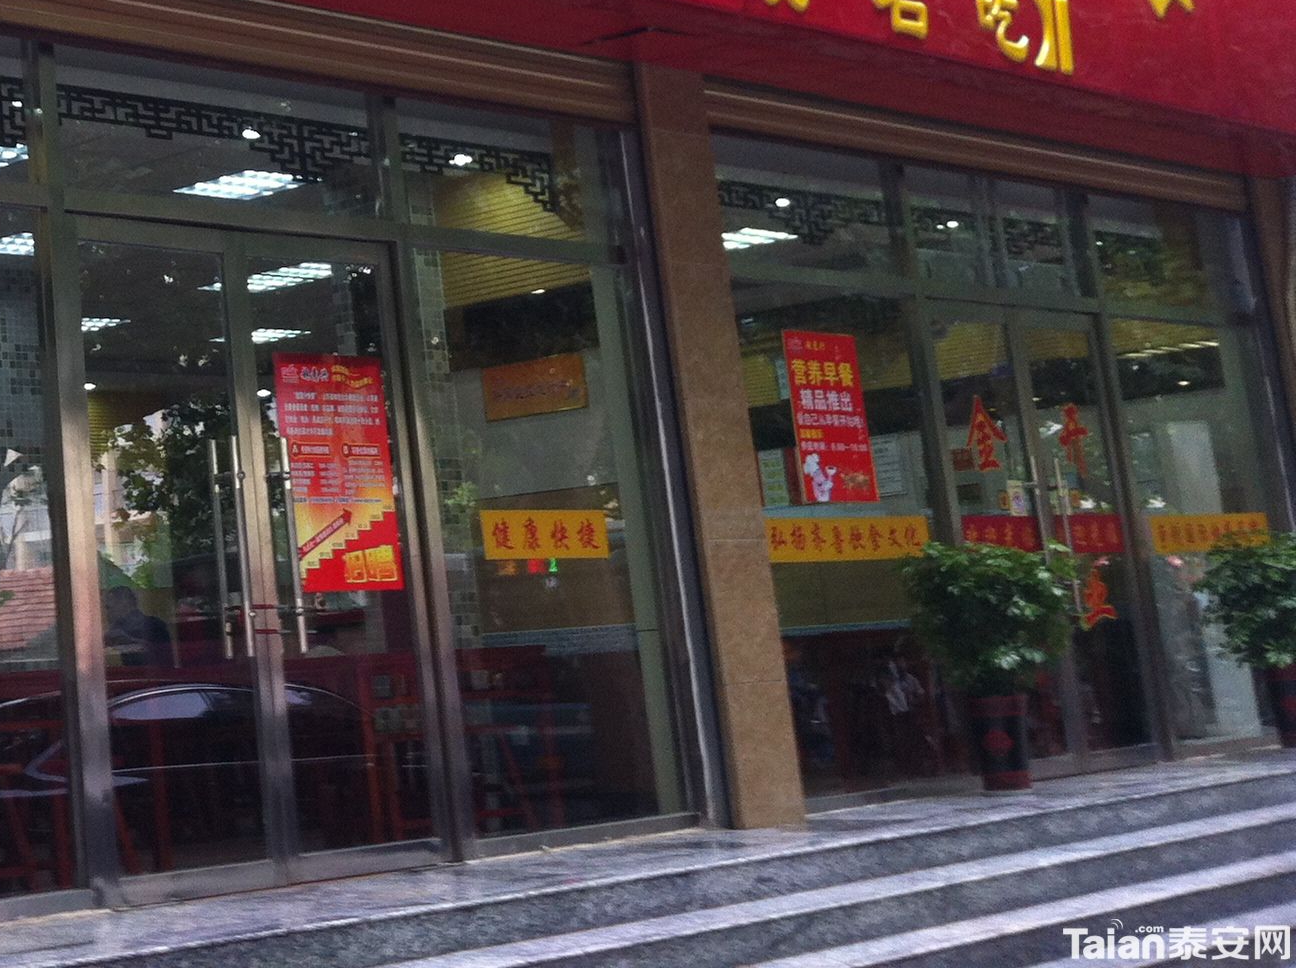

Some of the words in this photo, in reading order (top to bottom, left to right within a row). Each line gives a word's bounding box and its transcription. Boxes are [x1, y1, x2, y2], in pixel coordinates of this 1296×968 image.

[791, 359, 853, 387] 营养早餐
[492, 518, 601, 551] 健康快捷
